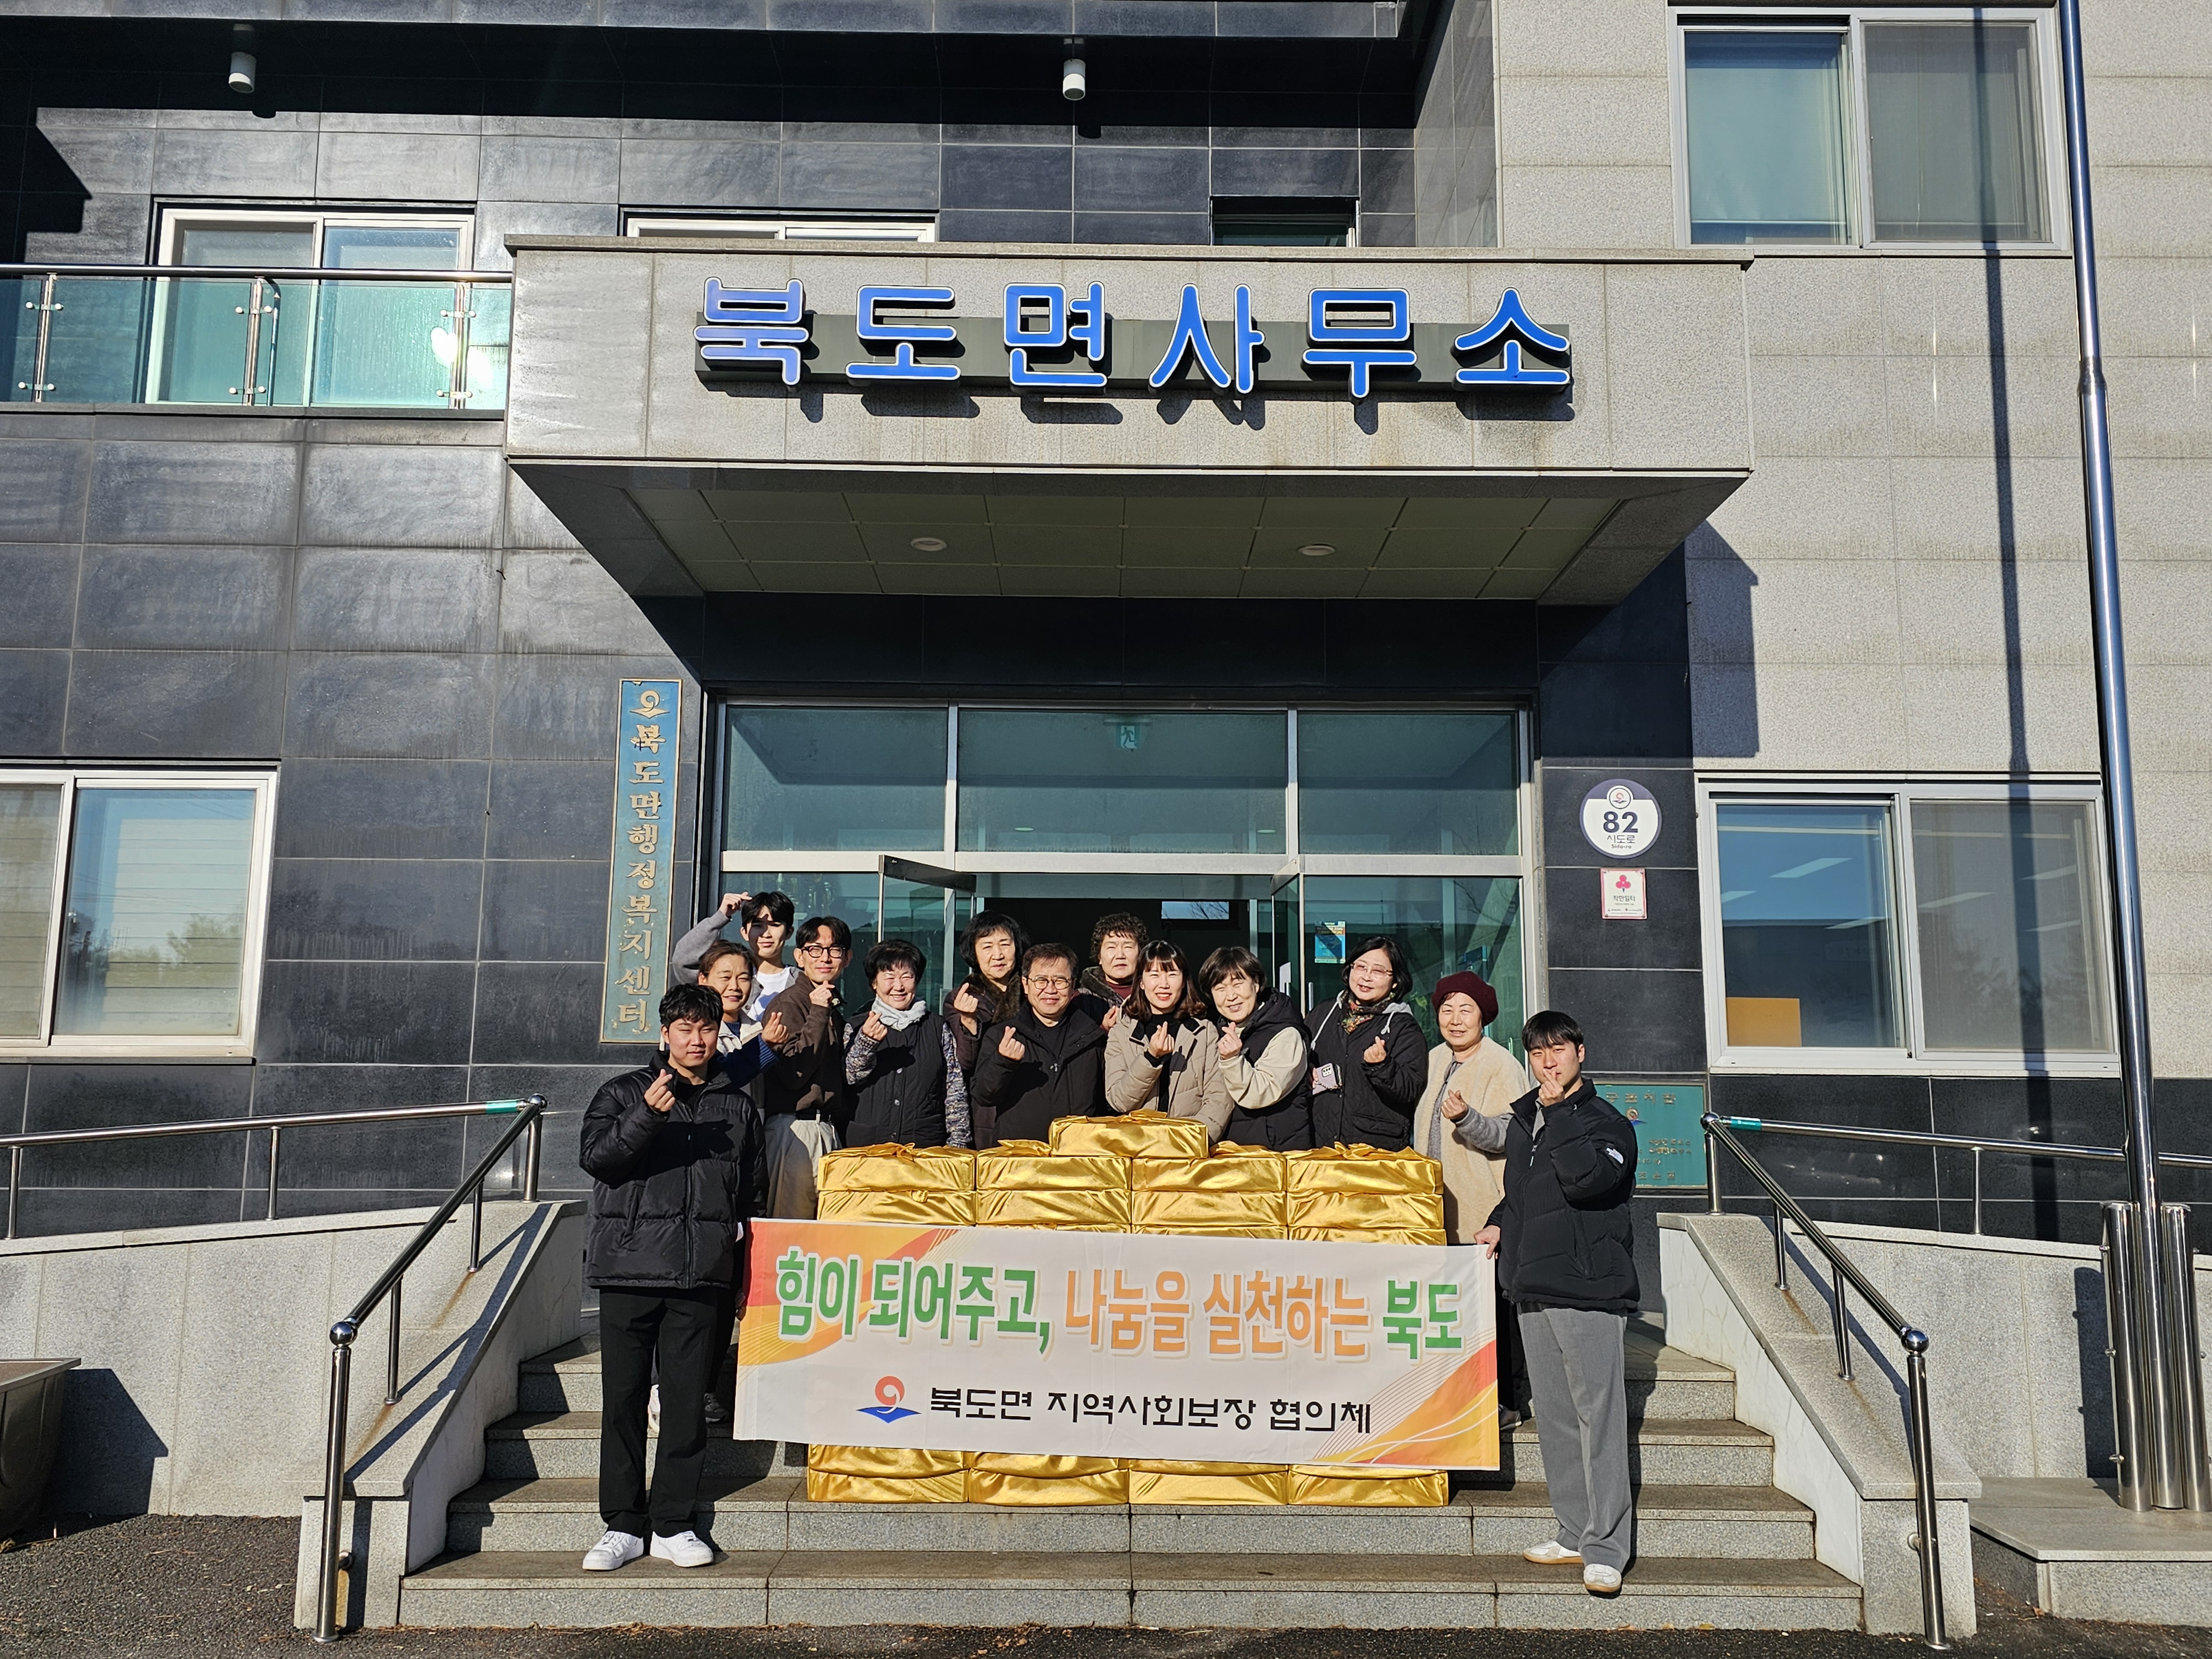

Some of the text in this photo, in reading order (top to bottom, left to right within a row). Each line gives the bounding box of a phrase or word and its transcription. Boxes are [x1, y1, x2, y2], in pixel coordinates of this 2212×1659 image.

[694, 277, 1571, 400] 북도면사무소
[1603, 811, 1639, 833] 82
[1606, 835, 1635, 844] 시도로
[779, 1251, 1462, 1360] 힘이 되어주고, 나눔을 실천하는 북도
[930, 1387, 1371, 1434] 북도면 지역사회보장 협의체
